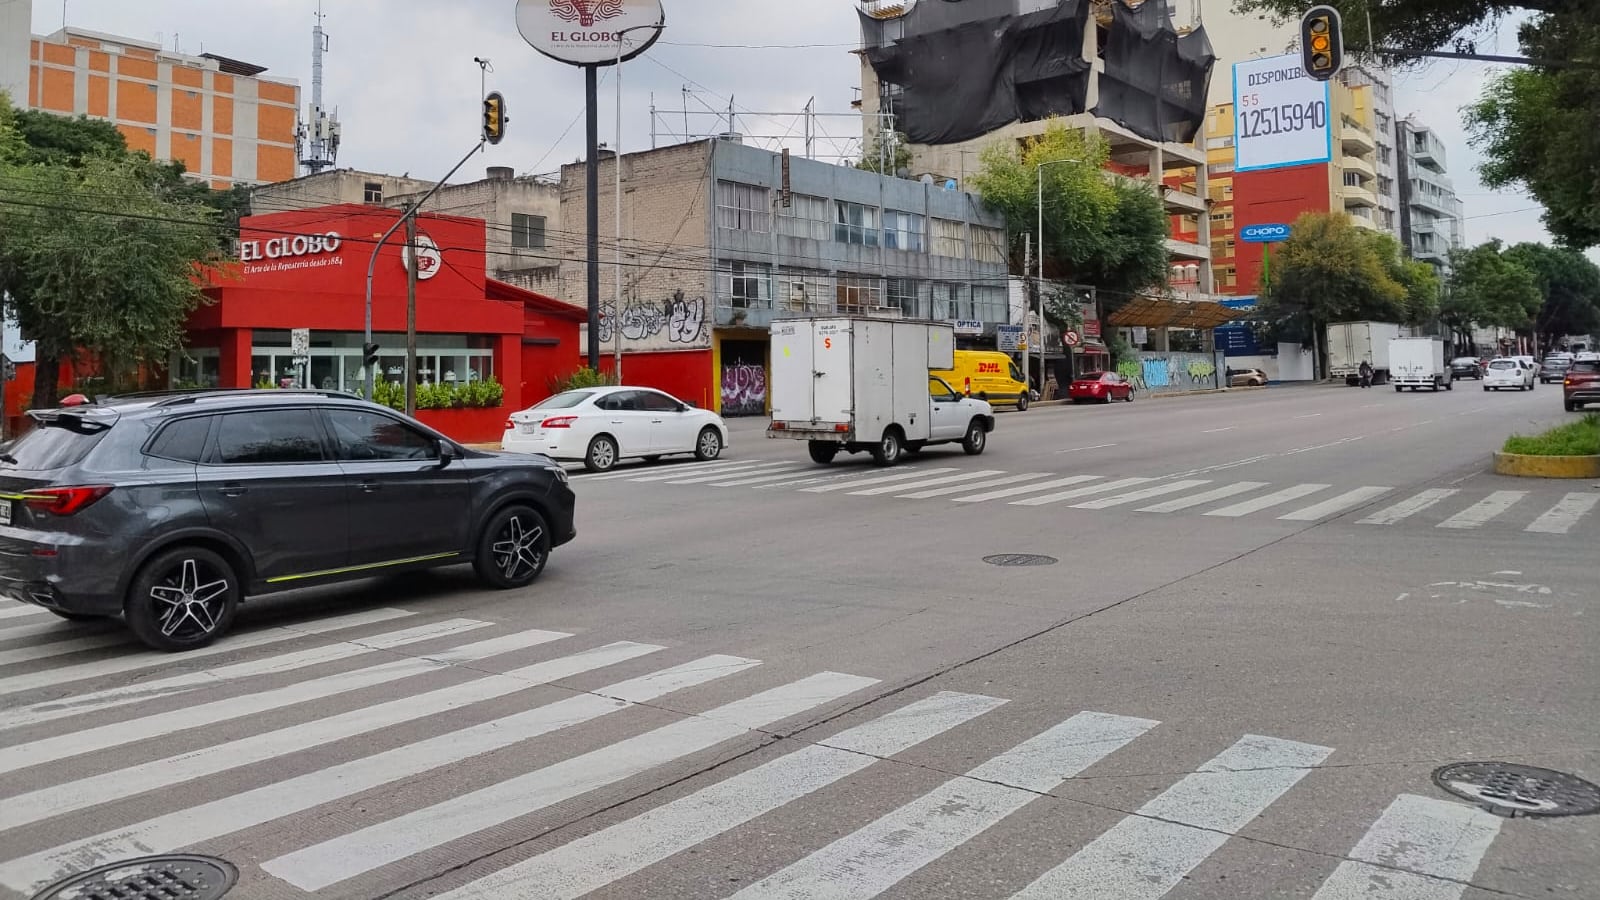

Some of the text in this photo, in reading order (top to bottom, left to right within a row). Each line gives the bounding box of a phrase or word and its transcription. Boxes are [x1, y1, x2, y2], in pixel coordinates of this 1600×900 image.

[551, 31, 622, 42] EL GLOBO
[1239, 100, 1326, 139] 12515940
[1246, 226, 1285, 236] CHOPO
[240, 231, 341, 261] EL GLOBO
[978, 362, 1002, 373] DHL
